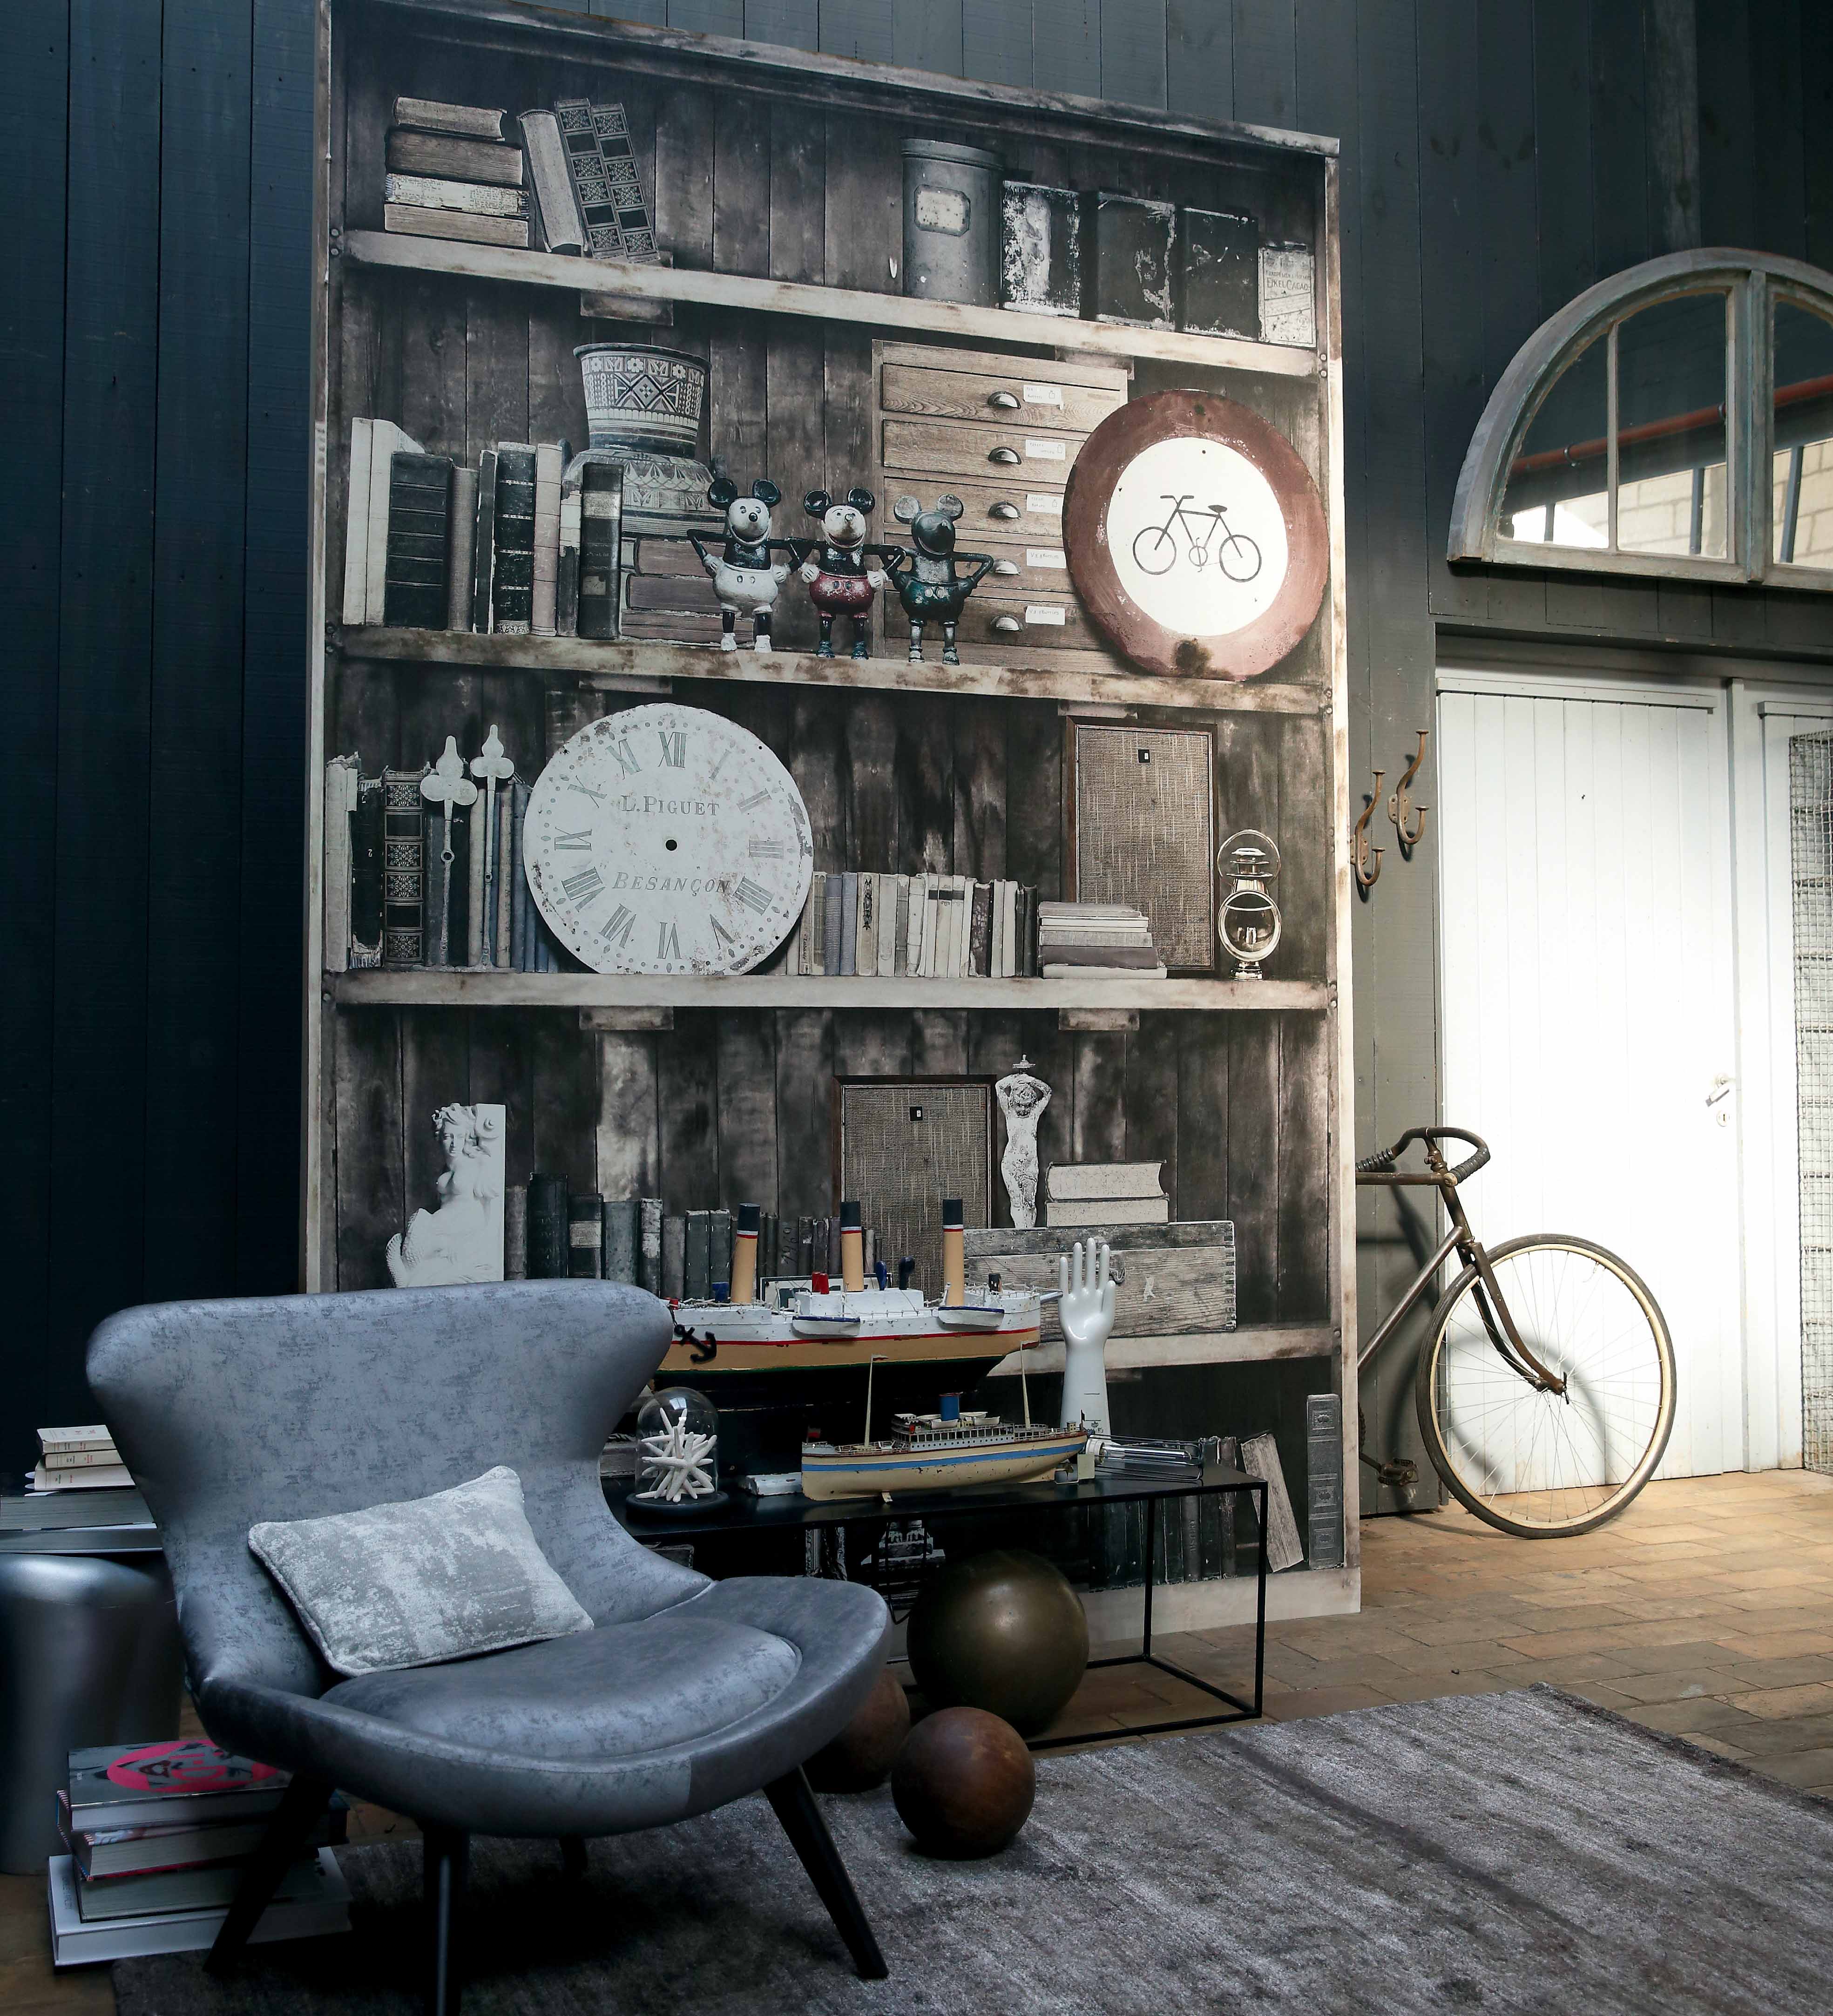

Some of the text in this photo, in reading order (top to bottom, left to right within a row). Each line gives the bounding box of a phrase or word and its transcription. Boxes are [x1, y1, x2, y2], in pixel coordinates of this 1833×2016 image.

[1286, 279, 1308, 291] CACAO
[605, 738, 643, 780] XI
[658, 731, 688, 768] XII
[567, 776, 607, 808] X
[612, 872, 730, 896] BESANÇON
